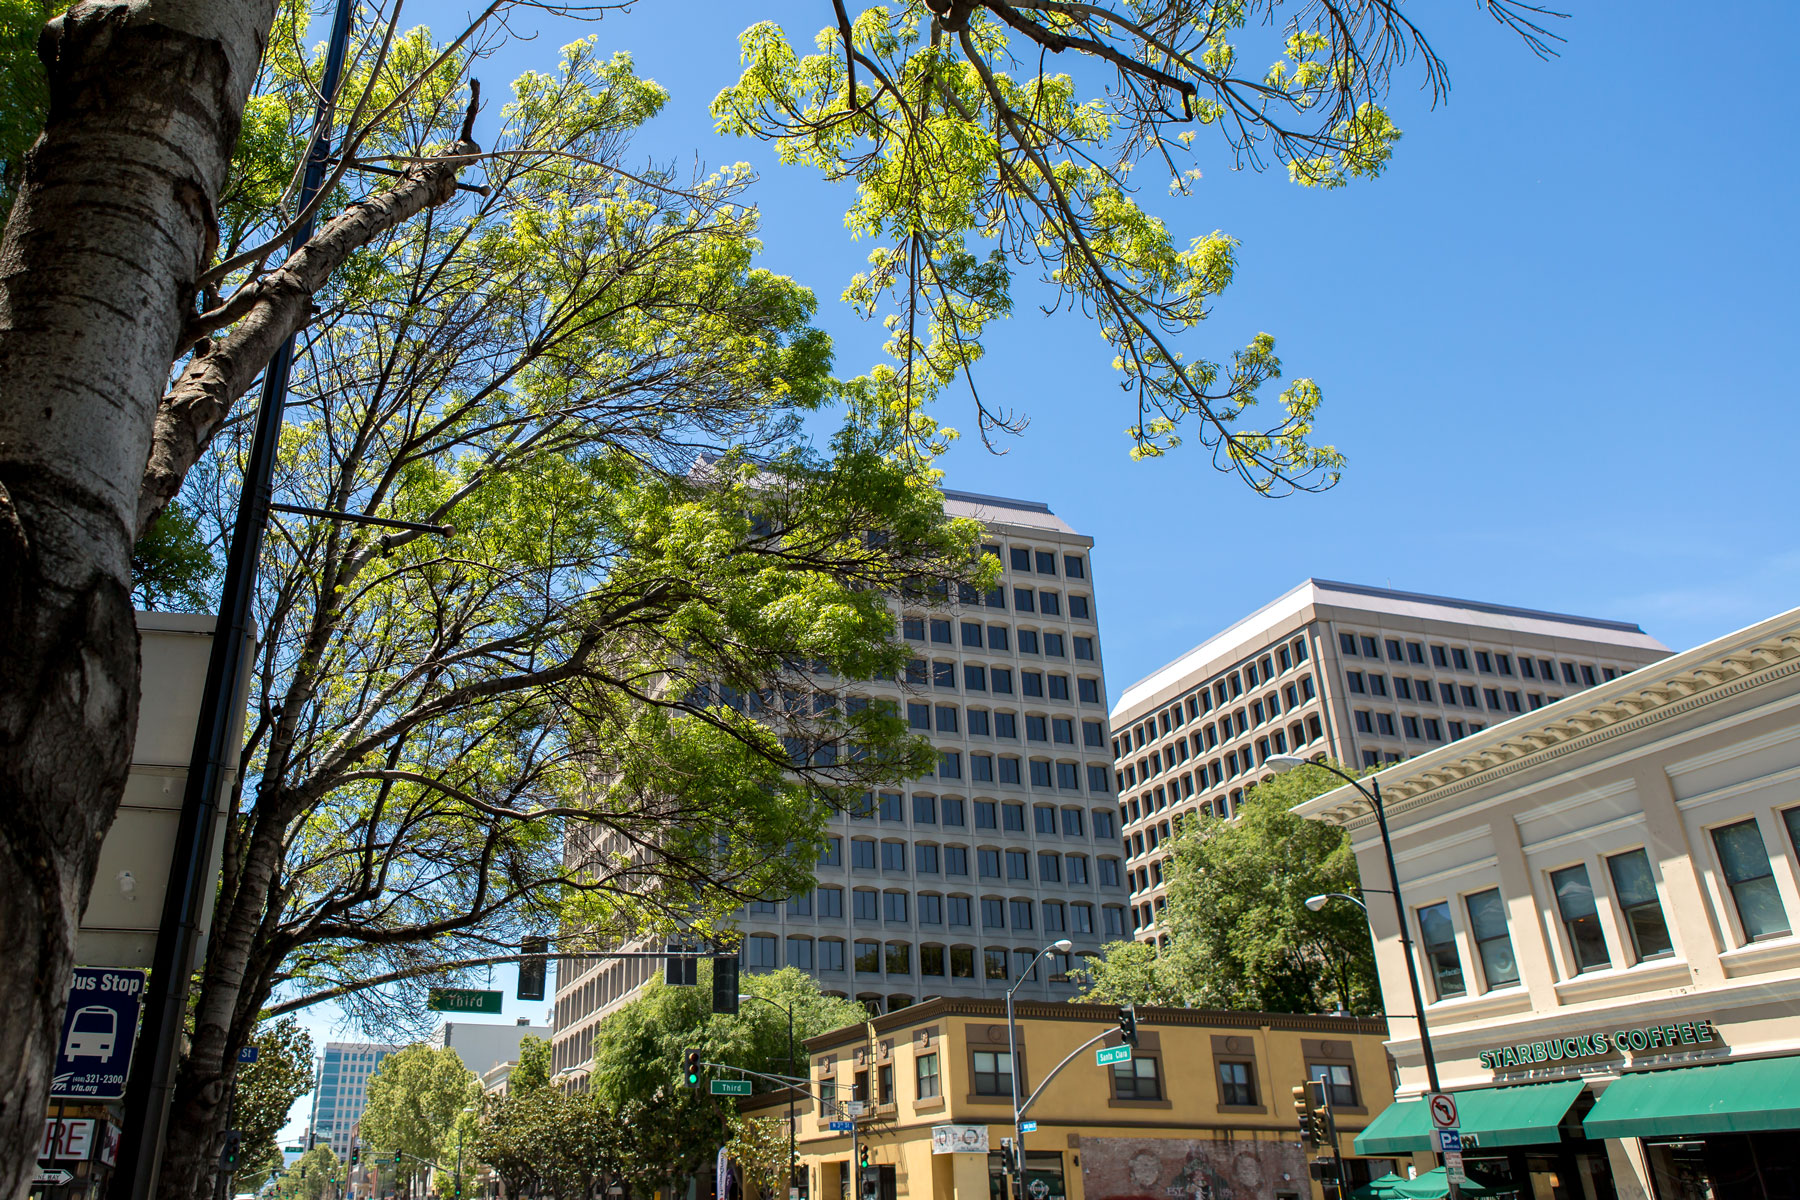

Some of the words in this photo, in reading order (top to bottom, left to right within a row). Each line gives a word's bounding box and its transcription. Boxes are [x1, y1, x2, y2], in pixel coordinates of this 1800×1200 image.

[100, 973, 140, 996] Stop
[448, 995, 484, 1008] Third
[1479, 1032, 1609, 1070] STARBUCKS
[1612, 1020, 1713, 1052] COFFEE
[1100, 1052, 1113, 1062] Santa
[1115, 1050, 1128, 1060] Clara
[85, 1074, 123, 1084] 321-2300
[71, 1083, 98, 1095] vta.org
[722, 1084, 742, 1092] Third
